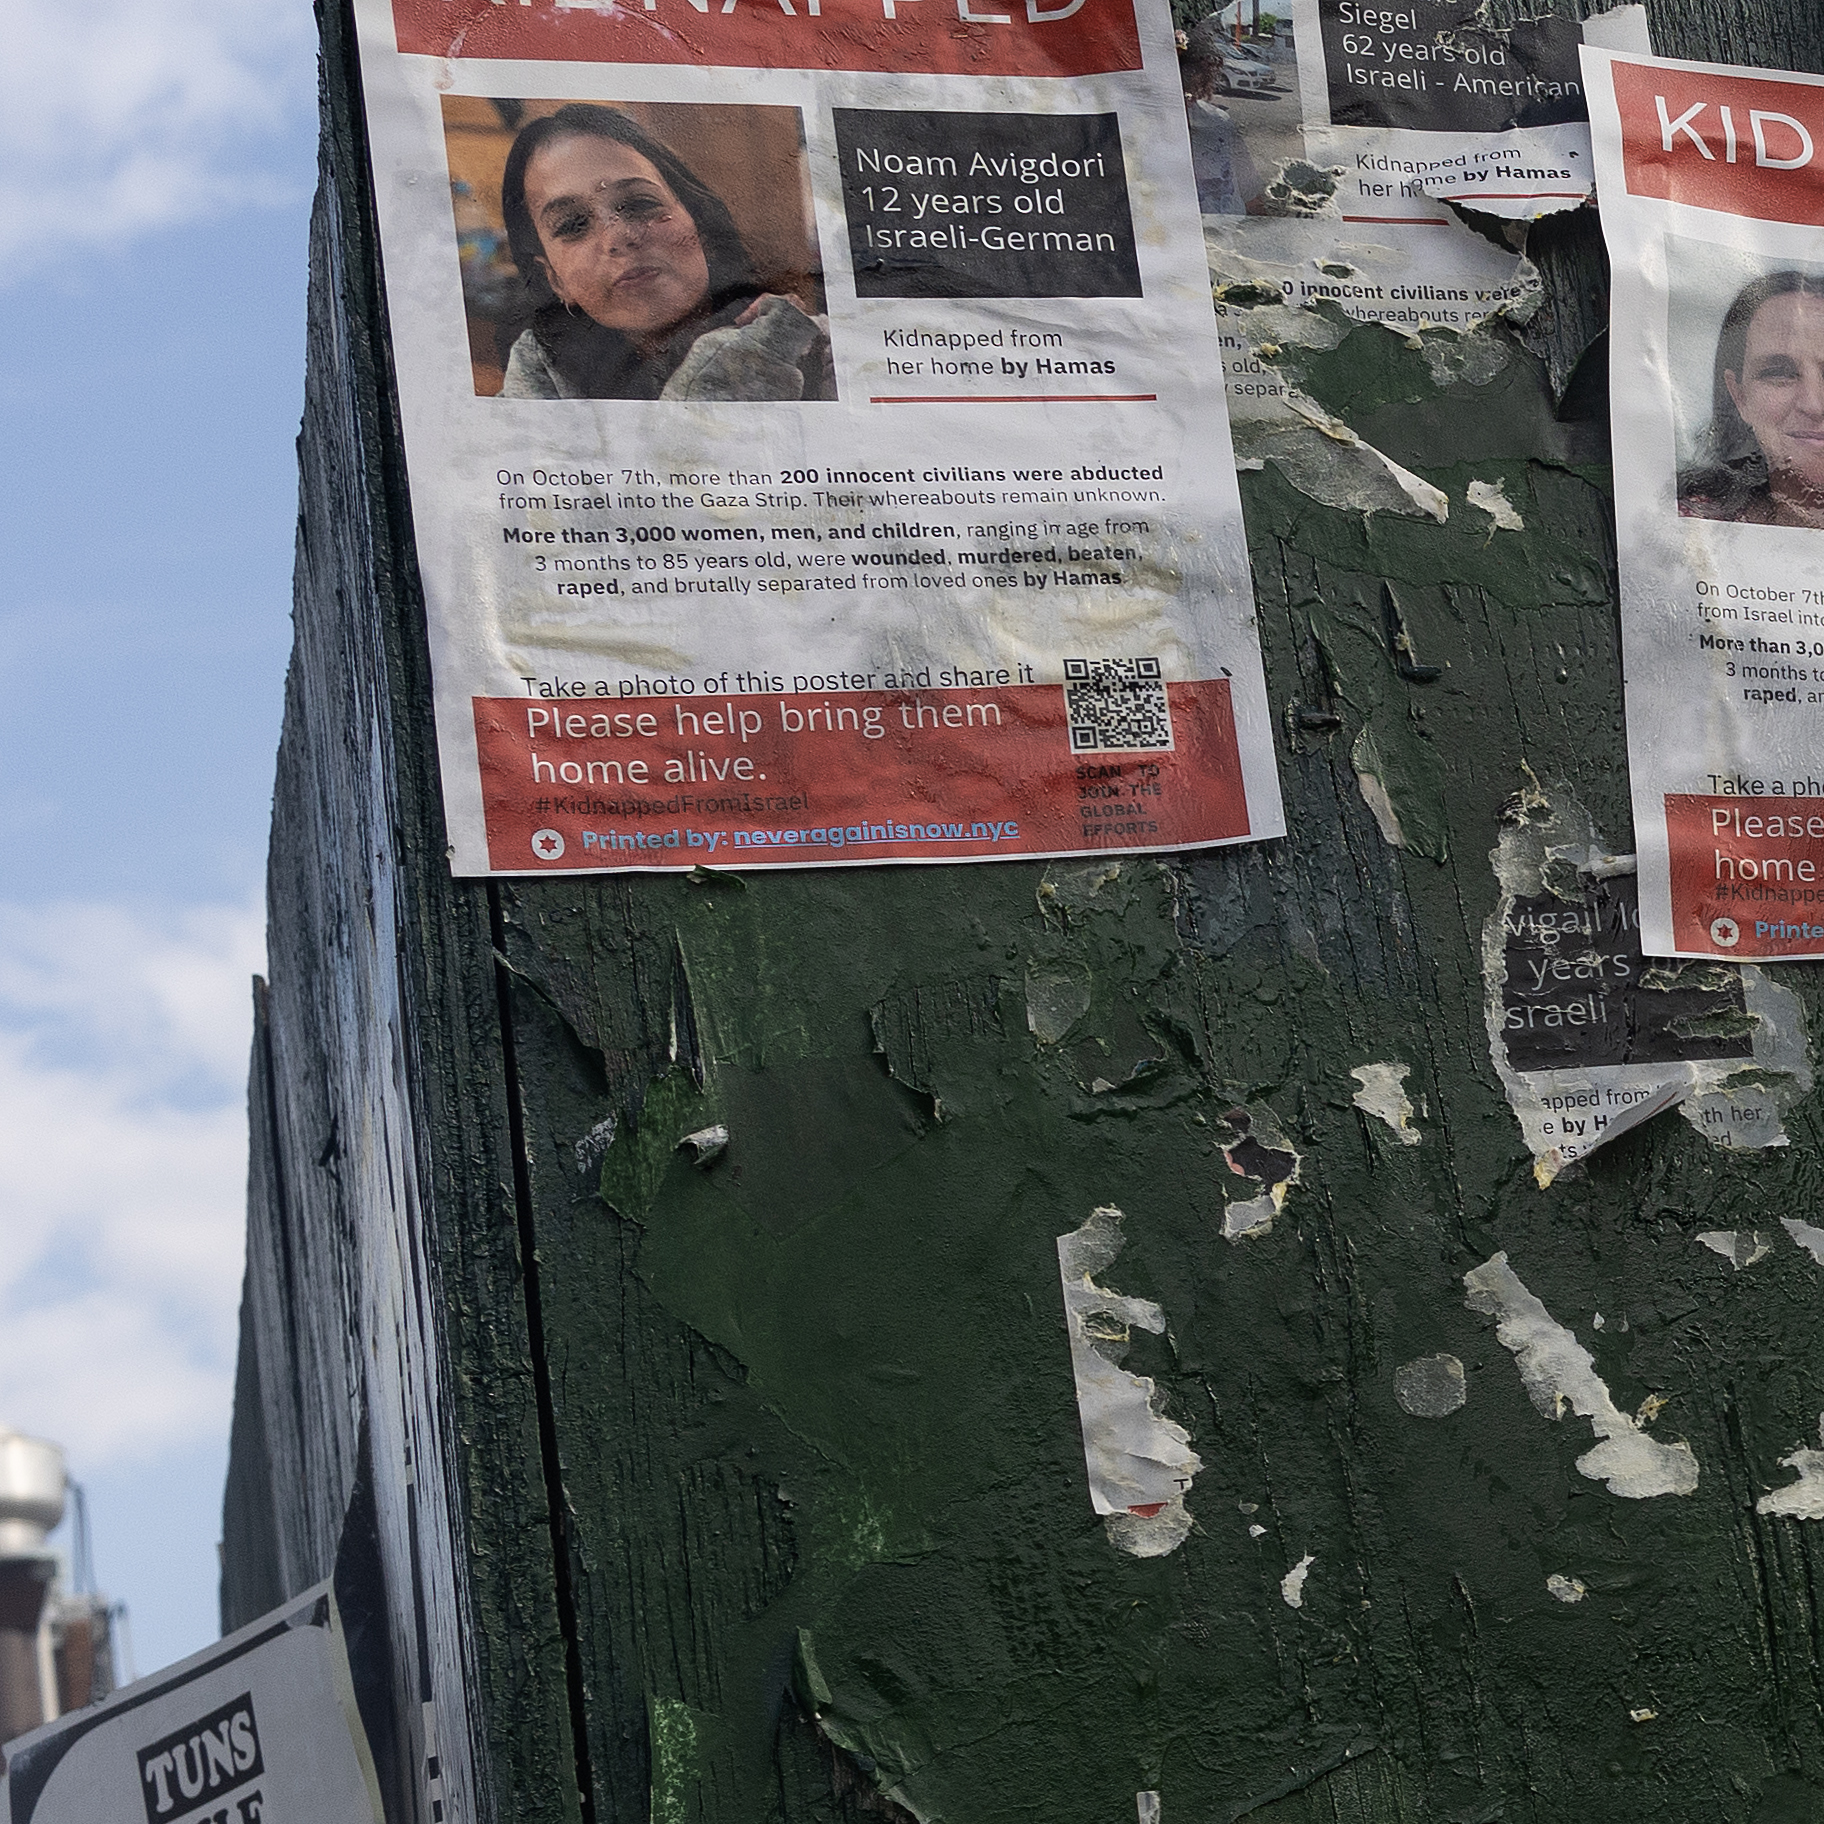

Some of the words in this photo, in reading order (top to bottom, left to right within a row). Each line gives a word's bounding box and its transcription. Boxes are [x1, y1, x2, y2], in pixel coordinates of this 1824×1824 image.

[1339, 2, 1418, 33] Siegel
[1343, 35, 1376, 57] 62
[1382, 39, 1454, 63] years
[1464, 45, 1506, 67] old
[856, 148, 958, 178] Noam
[969, 150, 1105, 184] Avigdori
[862, 186, 902, 214] 12
[911, 189, 1003, 219] years
[1014, 186, 1064, 216] old
[866, 223, 1116, 253] Israeli-German
[884, 328, 1003, 353] Kidnapped
[1011, 330, 1062, 349] from
[886, 358, 923, 377] her
[932, 357, 995, 377] home
[1001, 357, 1029, 380] by
[1035, 356, 1116, 377] Hamas
[144, 1709, 257, 1813] TUNS
